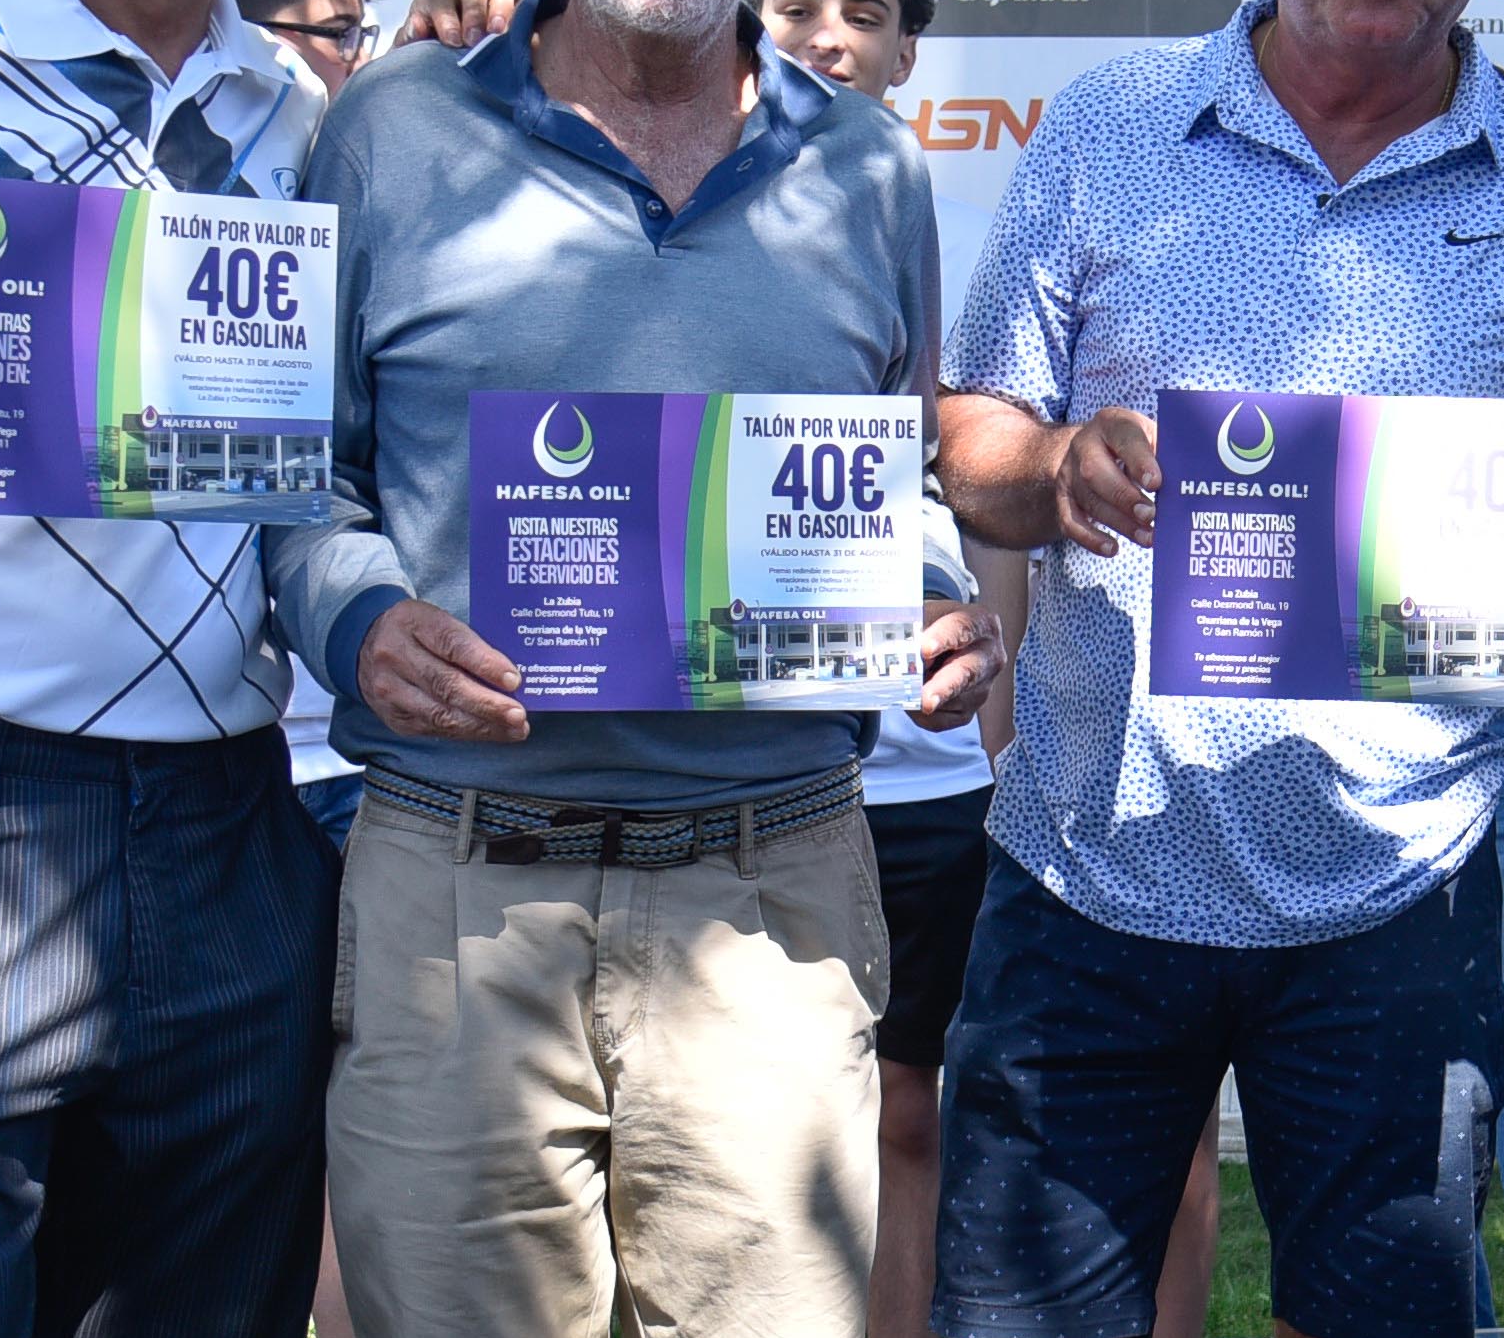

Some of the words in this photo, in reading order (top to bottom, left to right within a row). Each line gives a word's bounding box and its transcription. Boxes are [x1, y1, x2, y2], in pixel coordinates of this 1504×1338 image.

[160, 212, 212, 240] TALÓN
[218, 220, 250, 242] POR
[255, 222, 305, 246] VALOR
[310, 226, 330, 248] DE
[2, 278, 45, 296] OIL!
[187, 244, 299, 321] 40€
[181, 318, 206, 344] EN
[213, 319, 307, 349] GASOLINA
[7, 362, 31, 383] EN:
[743, 412, 794, 437] TALÓN
[801, 417, 833, 437] POR
[838, 417, 889, 438] VALOR
[895, 418, 915, 438] DE
[771, 442, 884, 511] 40€
[496, 485, 583, 500] HAFESA
[589, 485, 631, 500] OIL!
[1180, 481, 1263, 497] HAFESA
[1268, 483, 1308, 498] OIL!
[508, 517, 550, 535] VISITA
[551, 517, 618, 535] NUESTRAS
[766, 514, 791, 537] EN
[799, 514, 894, 538] GASOLINA
[1191, 511, 1230, 530] VISITA
[1231, 513, 1295, 532] NUESTRAS
[508, 537, 619, 562] ESTACIONES
[1190, 531, 1296, 558] ESTACIONES
[508, 564, 527, 584] DE
[529, 564, 593, 584] SERVICIO
[596, 565, 619, 584] EN:
[1189, 557, 1207, 576] DE
[1209, 557, 1270, 578] SERVICIO
[1272, 559, 1295, 579] EN:
[543, 597, 554, 605] La
[556, 597, 581, 605] Zubia
[511, 609, 532, 617] Calle
[535, 609, 576, 617] Desmond
[579, 609, 600, 618] Tutu,
[603, 609, 613, 617] 19
[517, 626, 559, 634] Churriana
[562, 626, 573, 634] de
[575, 626, 583, 634] la
[585, 626, 607, 635] Vega
